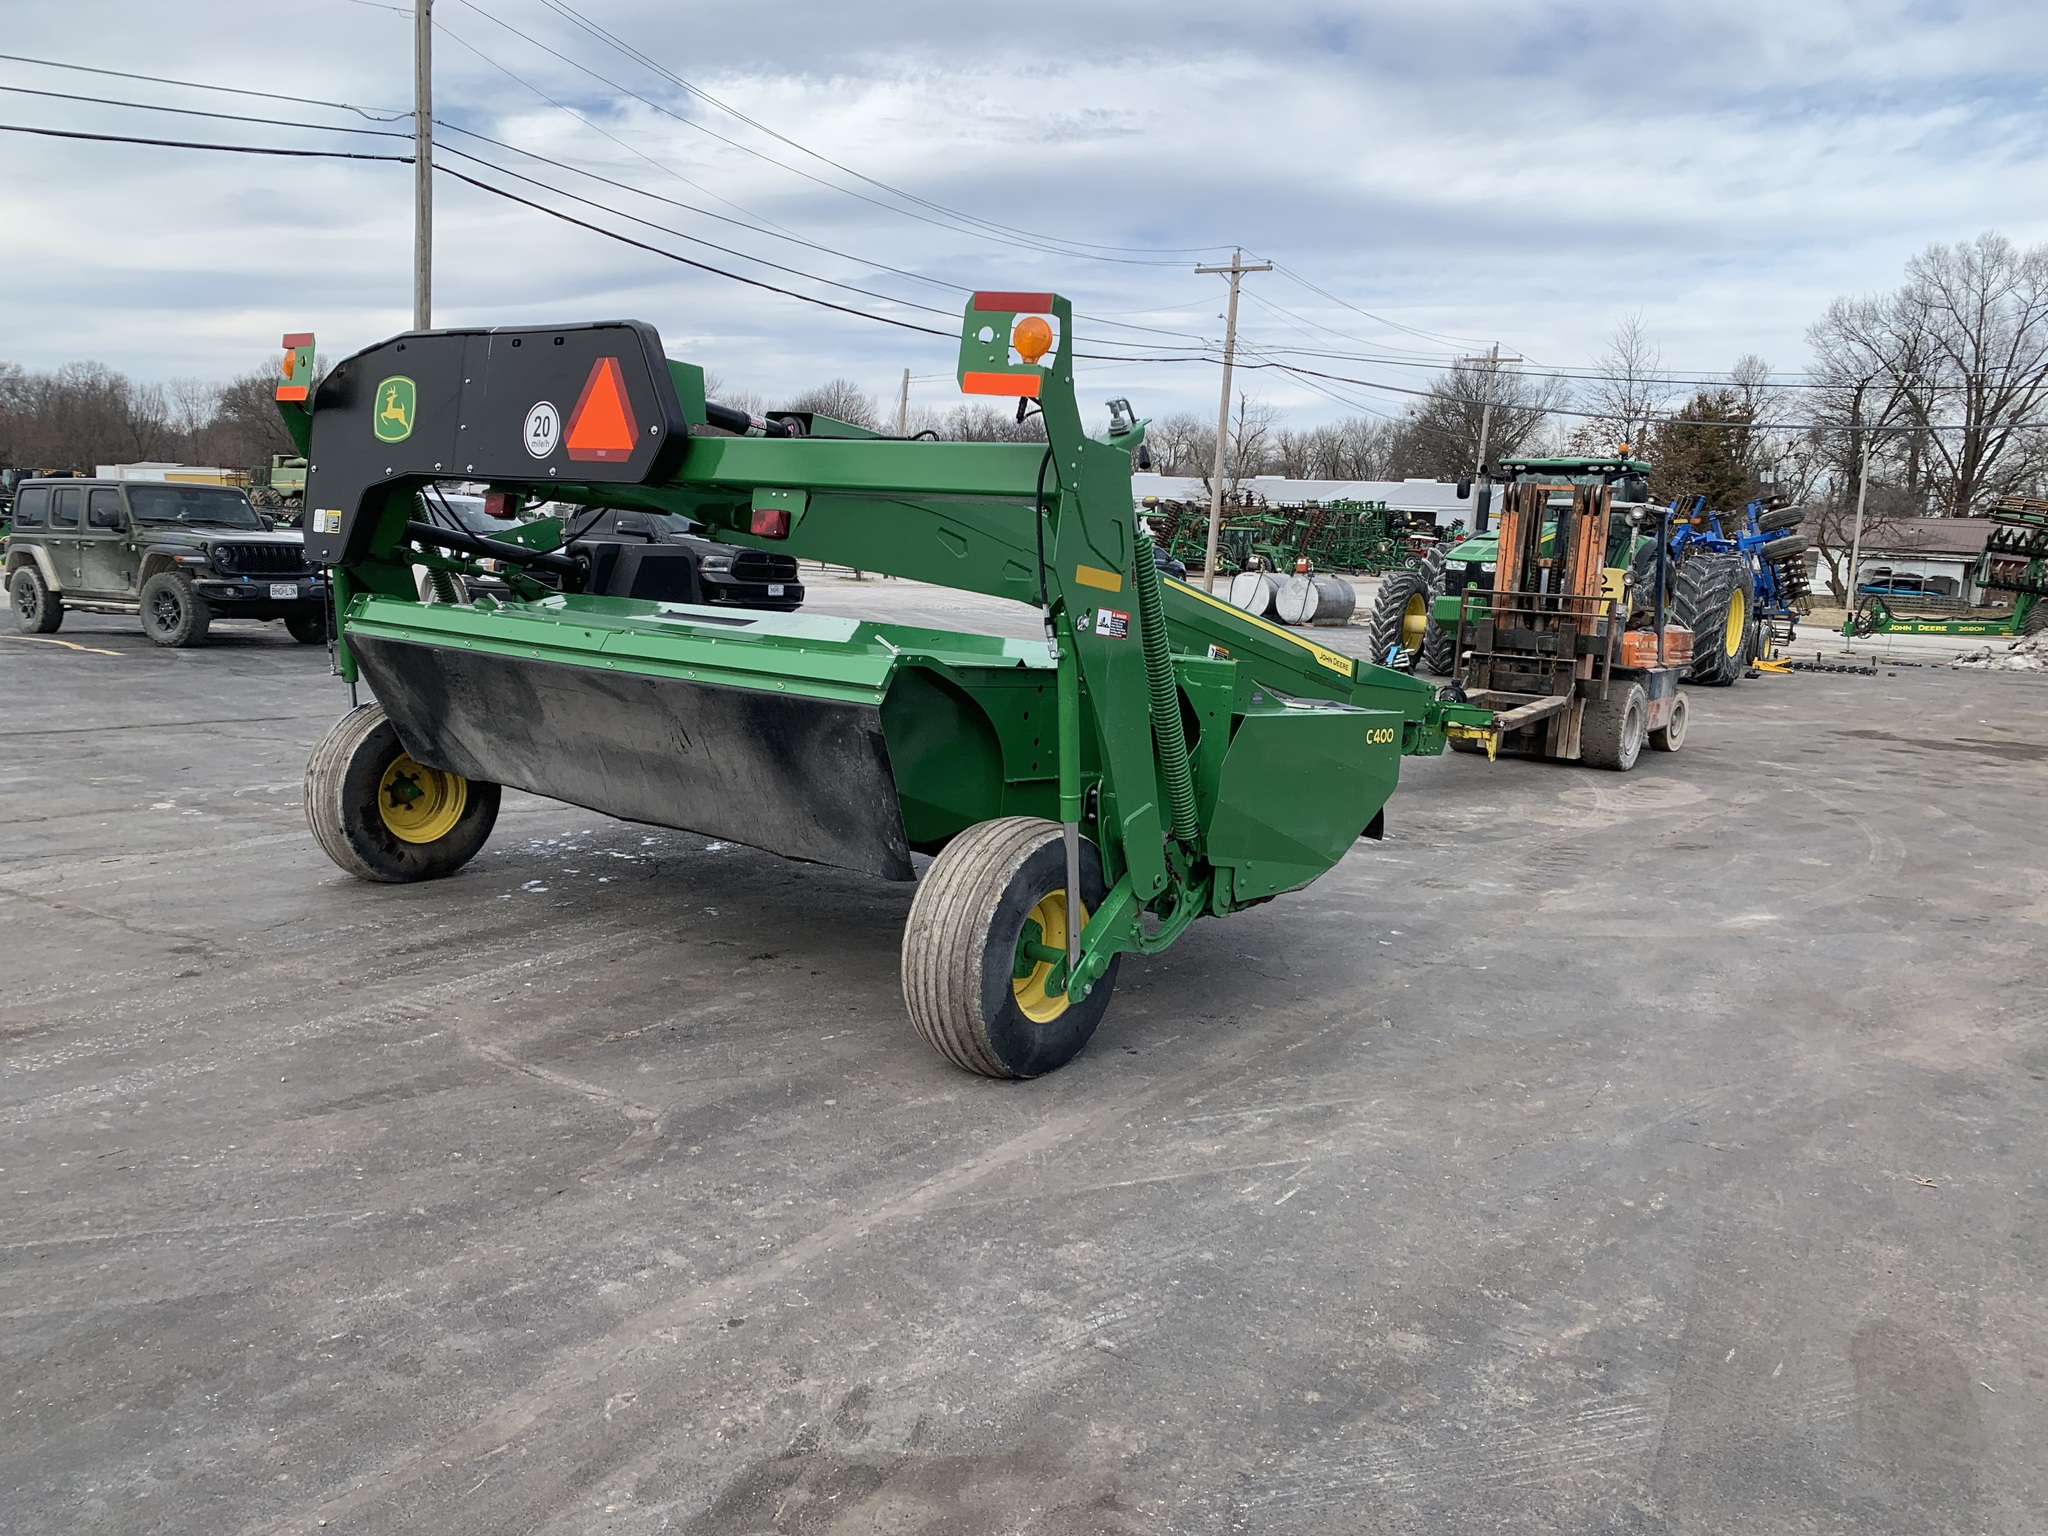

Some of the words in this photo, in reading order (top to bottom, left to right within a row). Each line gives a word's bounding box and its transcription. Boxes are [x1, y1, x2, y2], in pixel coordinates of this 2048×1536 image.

[533, 415, 550, 437] 20
[1918, 624, 1947, 632] DEERE
[1319, 652, 1333, 664] JOHN
[1333, 657, 1349, 672] DEERE
[1366, 728, 1394, 745] C400
